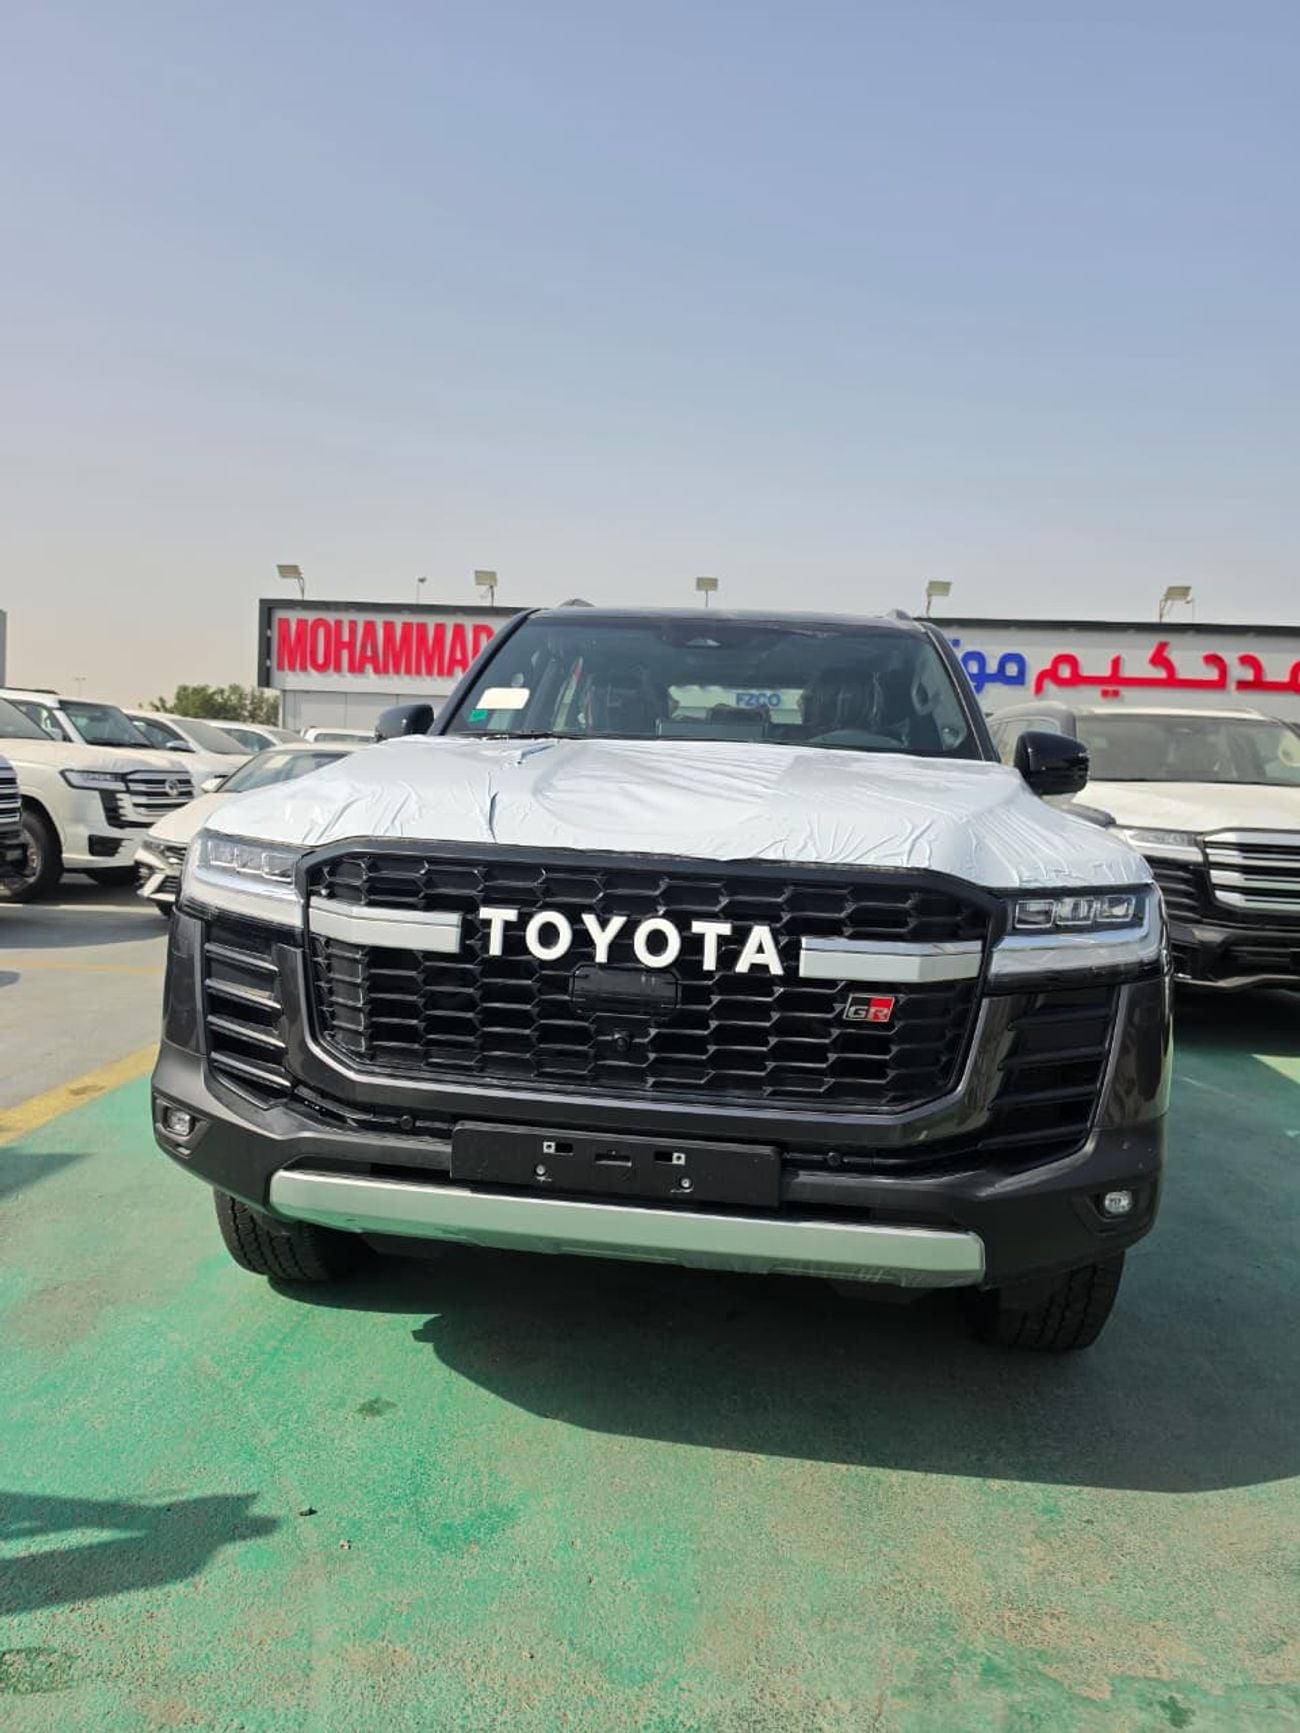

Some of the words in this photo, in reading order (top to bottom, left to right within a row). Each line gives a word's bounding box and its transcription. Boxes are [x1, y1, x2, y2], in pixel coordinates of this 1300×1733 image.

[735, 692, 781, 707] FZCO
[479, 907, 784, 976] TOYOTA
[846, 1003, 892, 1021] GR
